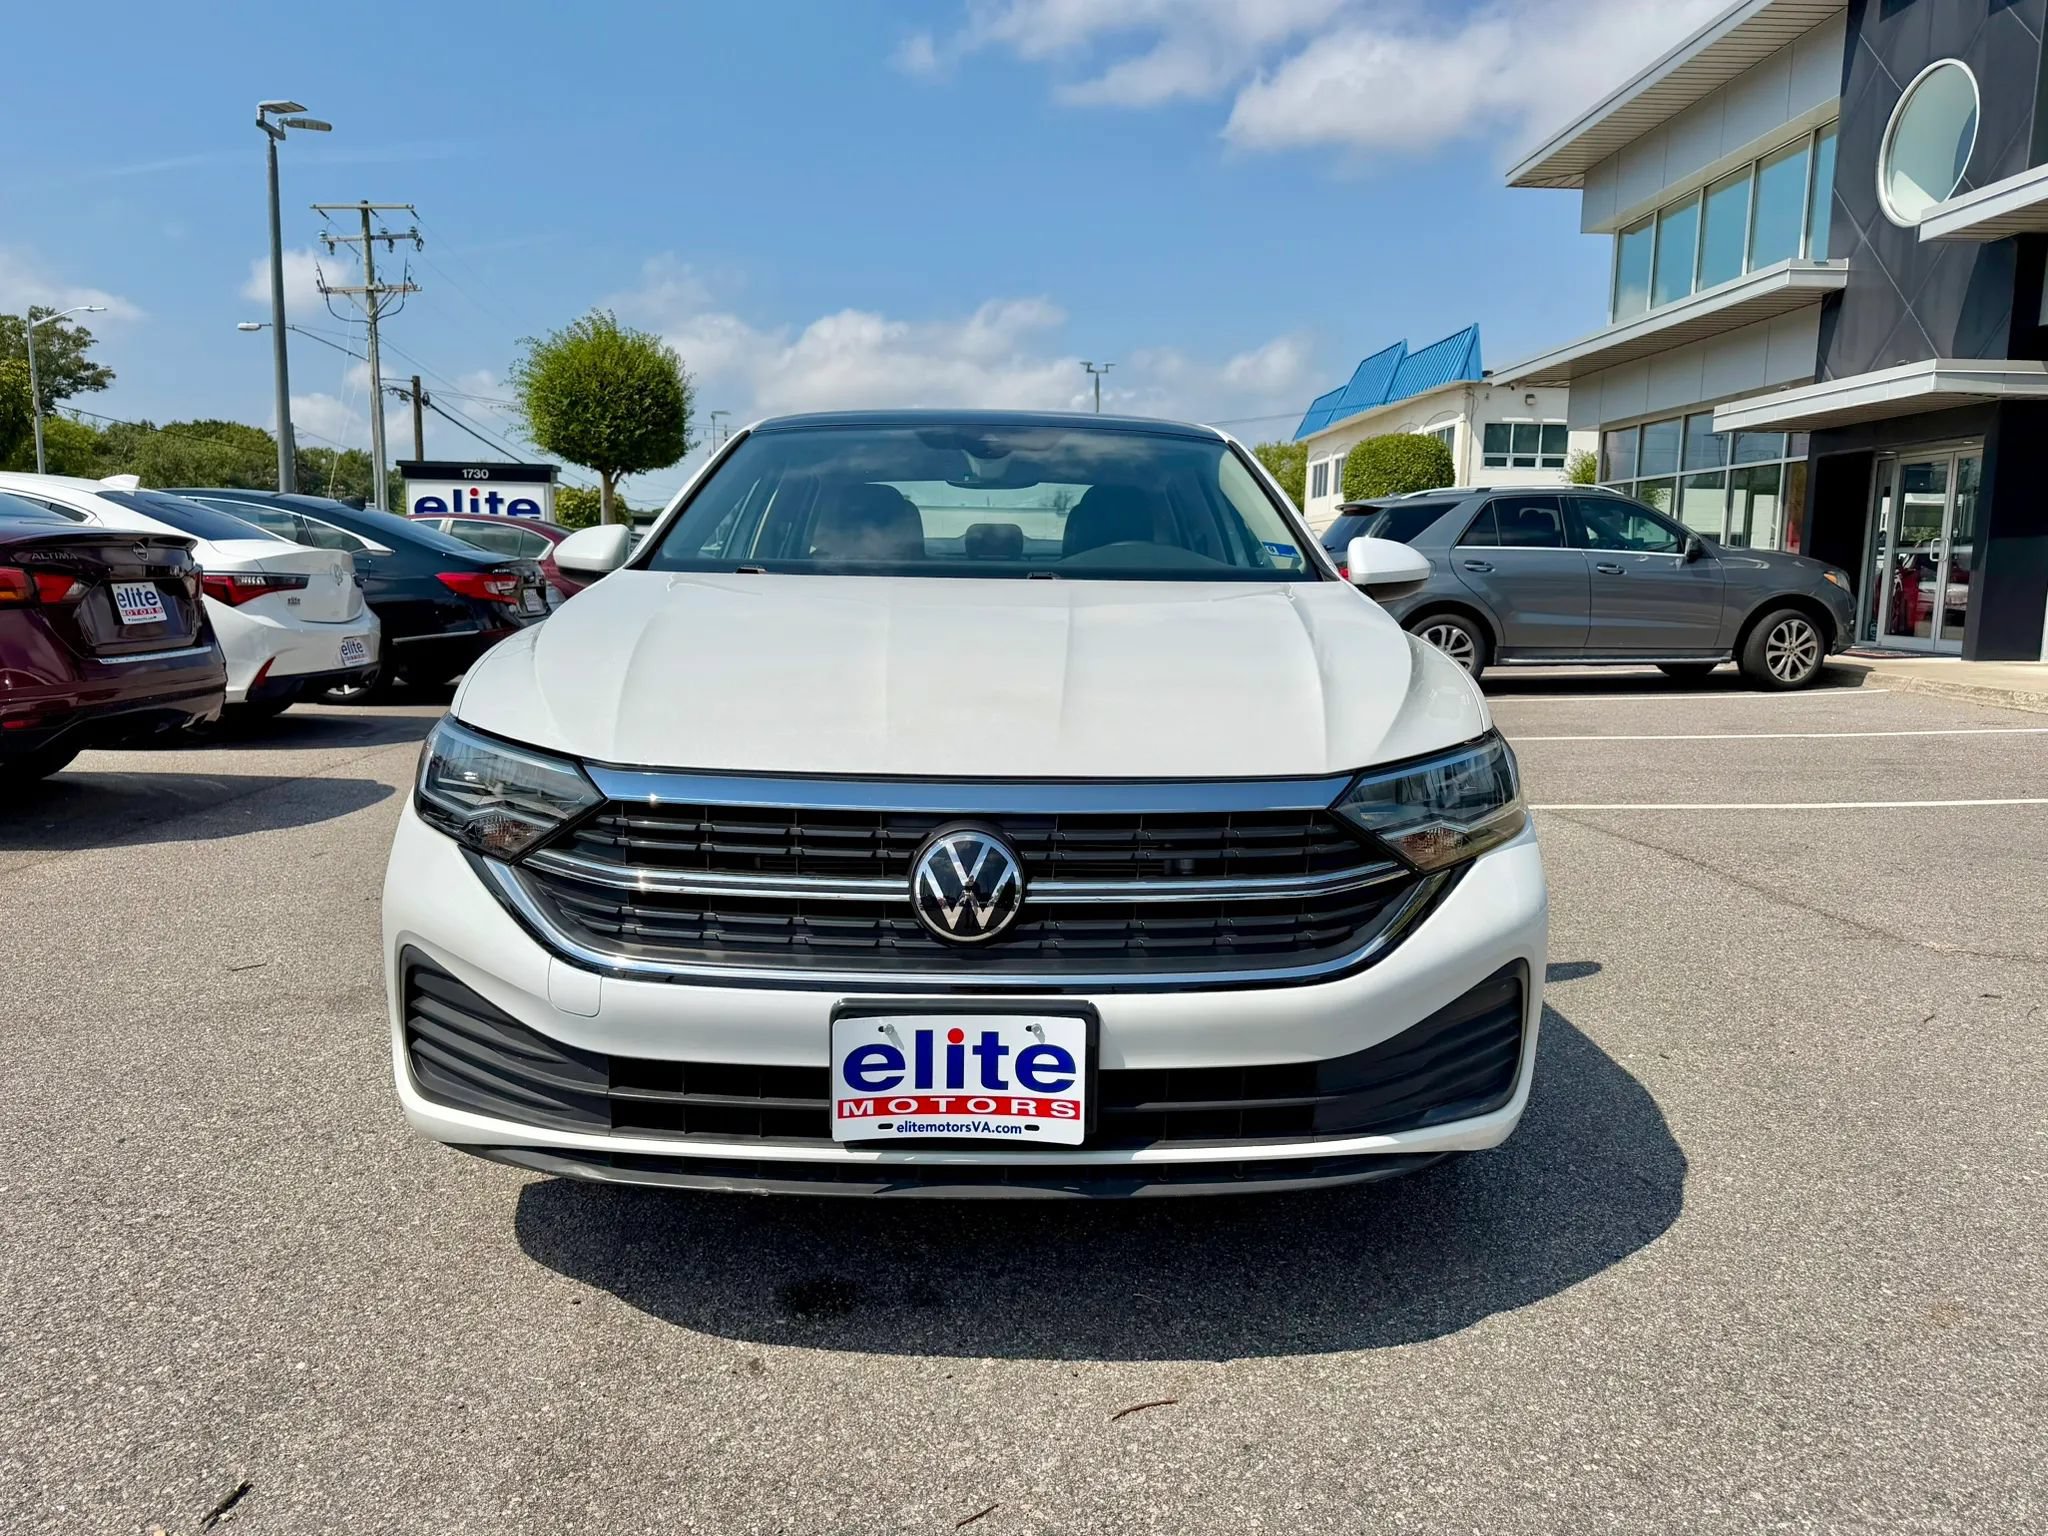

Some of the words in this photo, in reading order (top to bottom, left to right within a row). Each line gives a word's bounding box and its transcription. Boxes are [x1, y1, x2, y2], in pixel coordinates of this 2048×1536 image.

[462, 469, 489, 479] 1730
[414, 487, 541, 519] elite
[32, 552, 78, 560] ALTIMA
[116, 587, 158, 608] elite
[341, 640, 364, 656] elite
[843, 1028, 1077, 1094] elite
[842, 1097, 1077, 1118] MOTORS
[896, 1121, 1022, 1135] elitemotorsVA.com
